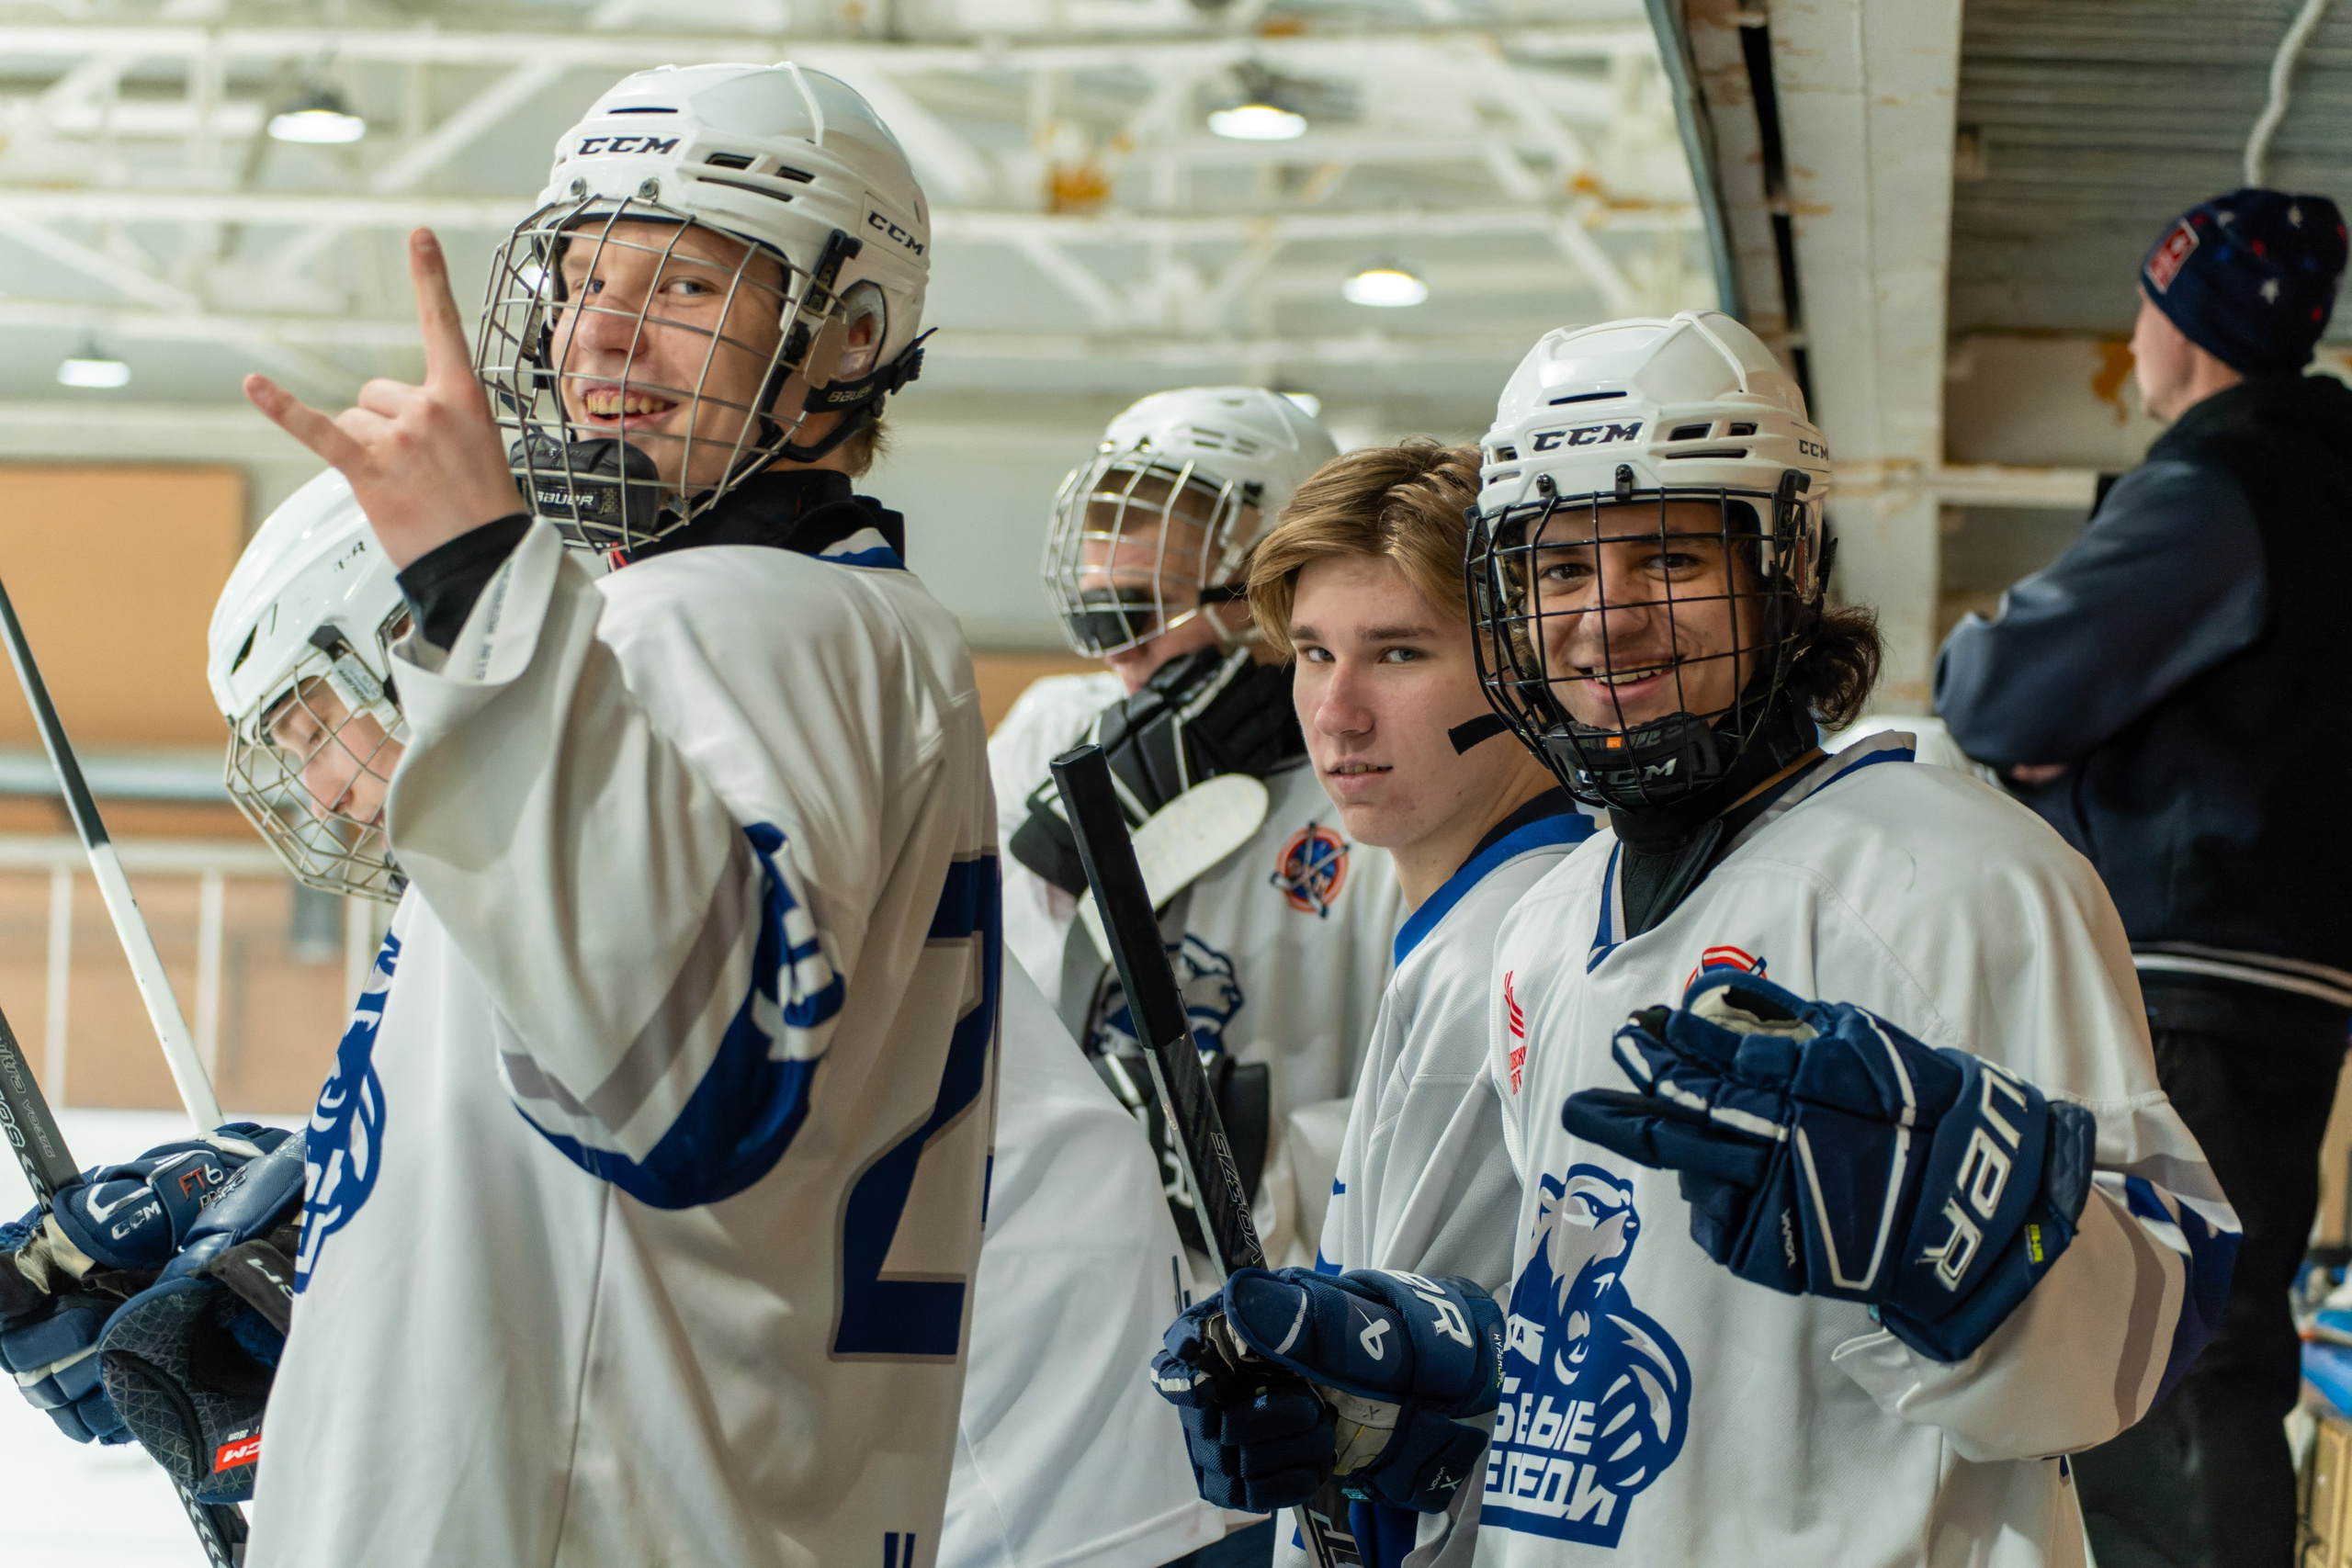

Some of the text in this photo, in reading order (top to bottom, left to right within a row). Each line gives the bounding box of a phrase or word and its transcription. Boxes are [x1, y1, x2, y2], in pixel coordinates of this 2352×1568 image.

[578, 137, 681, 155] CCM
[868, 209, 924, 256] CCM
[1532, 423, 1643, 452] CCM
[1798, 438, 1829, 460] CCM
[177, 1163, 224, 1201] FT6
[110, 1200, 162, 1240] CCM
[222, 1441, 261, 1463] CM
